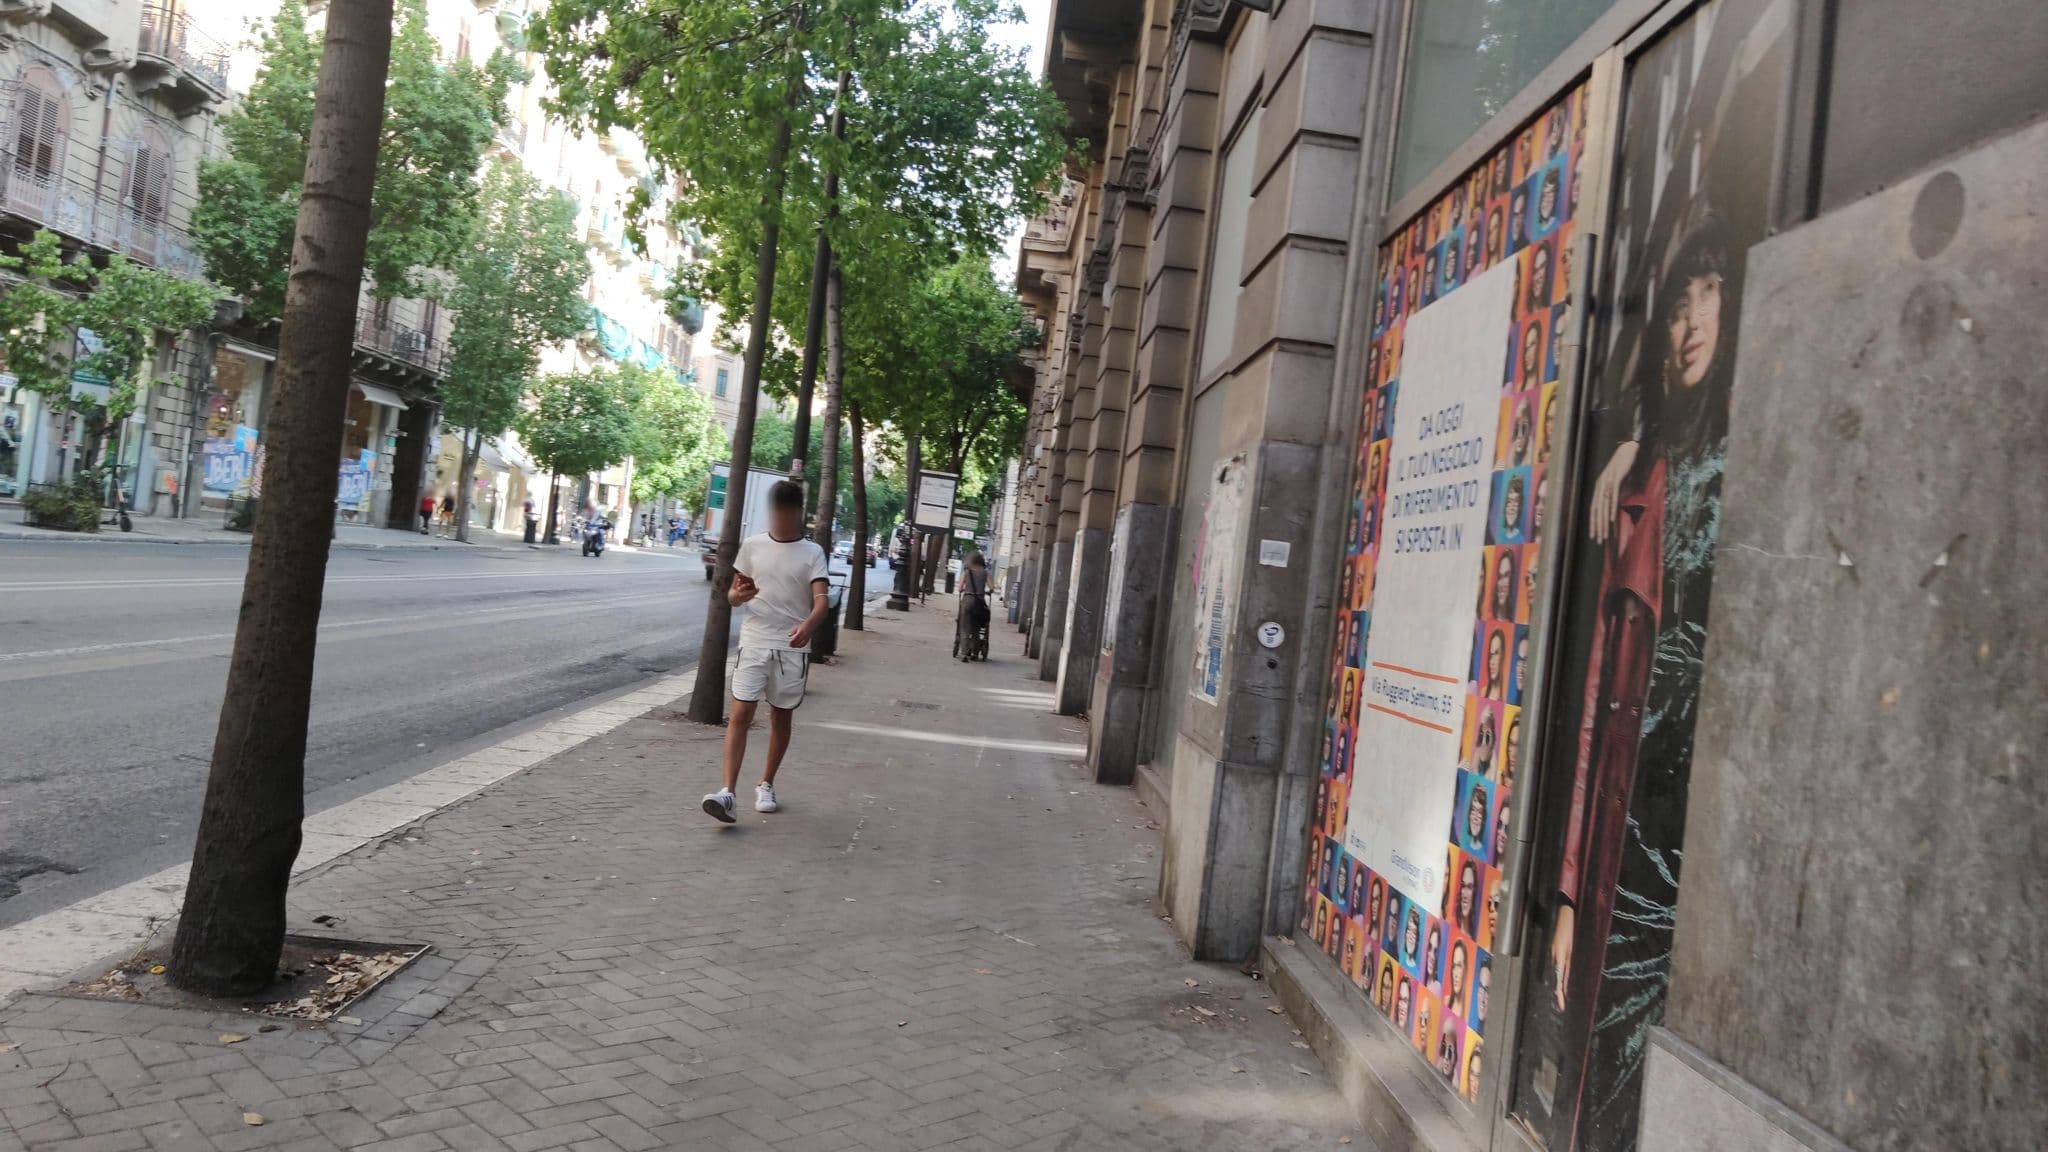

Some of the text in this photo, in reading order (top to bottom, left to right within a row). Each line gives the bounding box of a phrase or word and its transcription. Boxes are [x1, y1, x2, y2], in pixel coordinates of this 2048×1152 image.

[1419, 402, 1464, 440] DA OGGI
[1408, 451, 1430, 479] TUO
[1431, 436, 1483, 474] NEGOZIO
[1392, 479, 1478, 518] DI RIFERIMENTO
[1394, 522, 1464, 554] SI SPOSTA IN
[1372, 676, 1383, 694] Via
